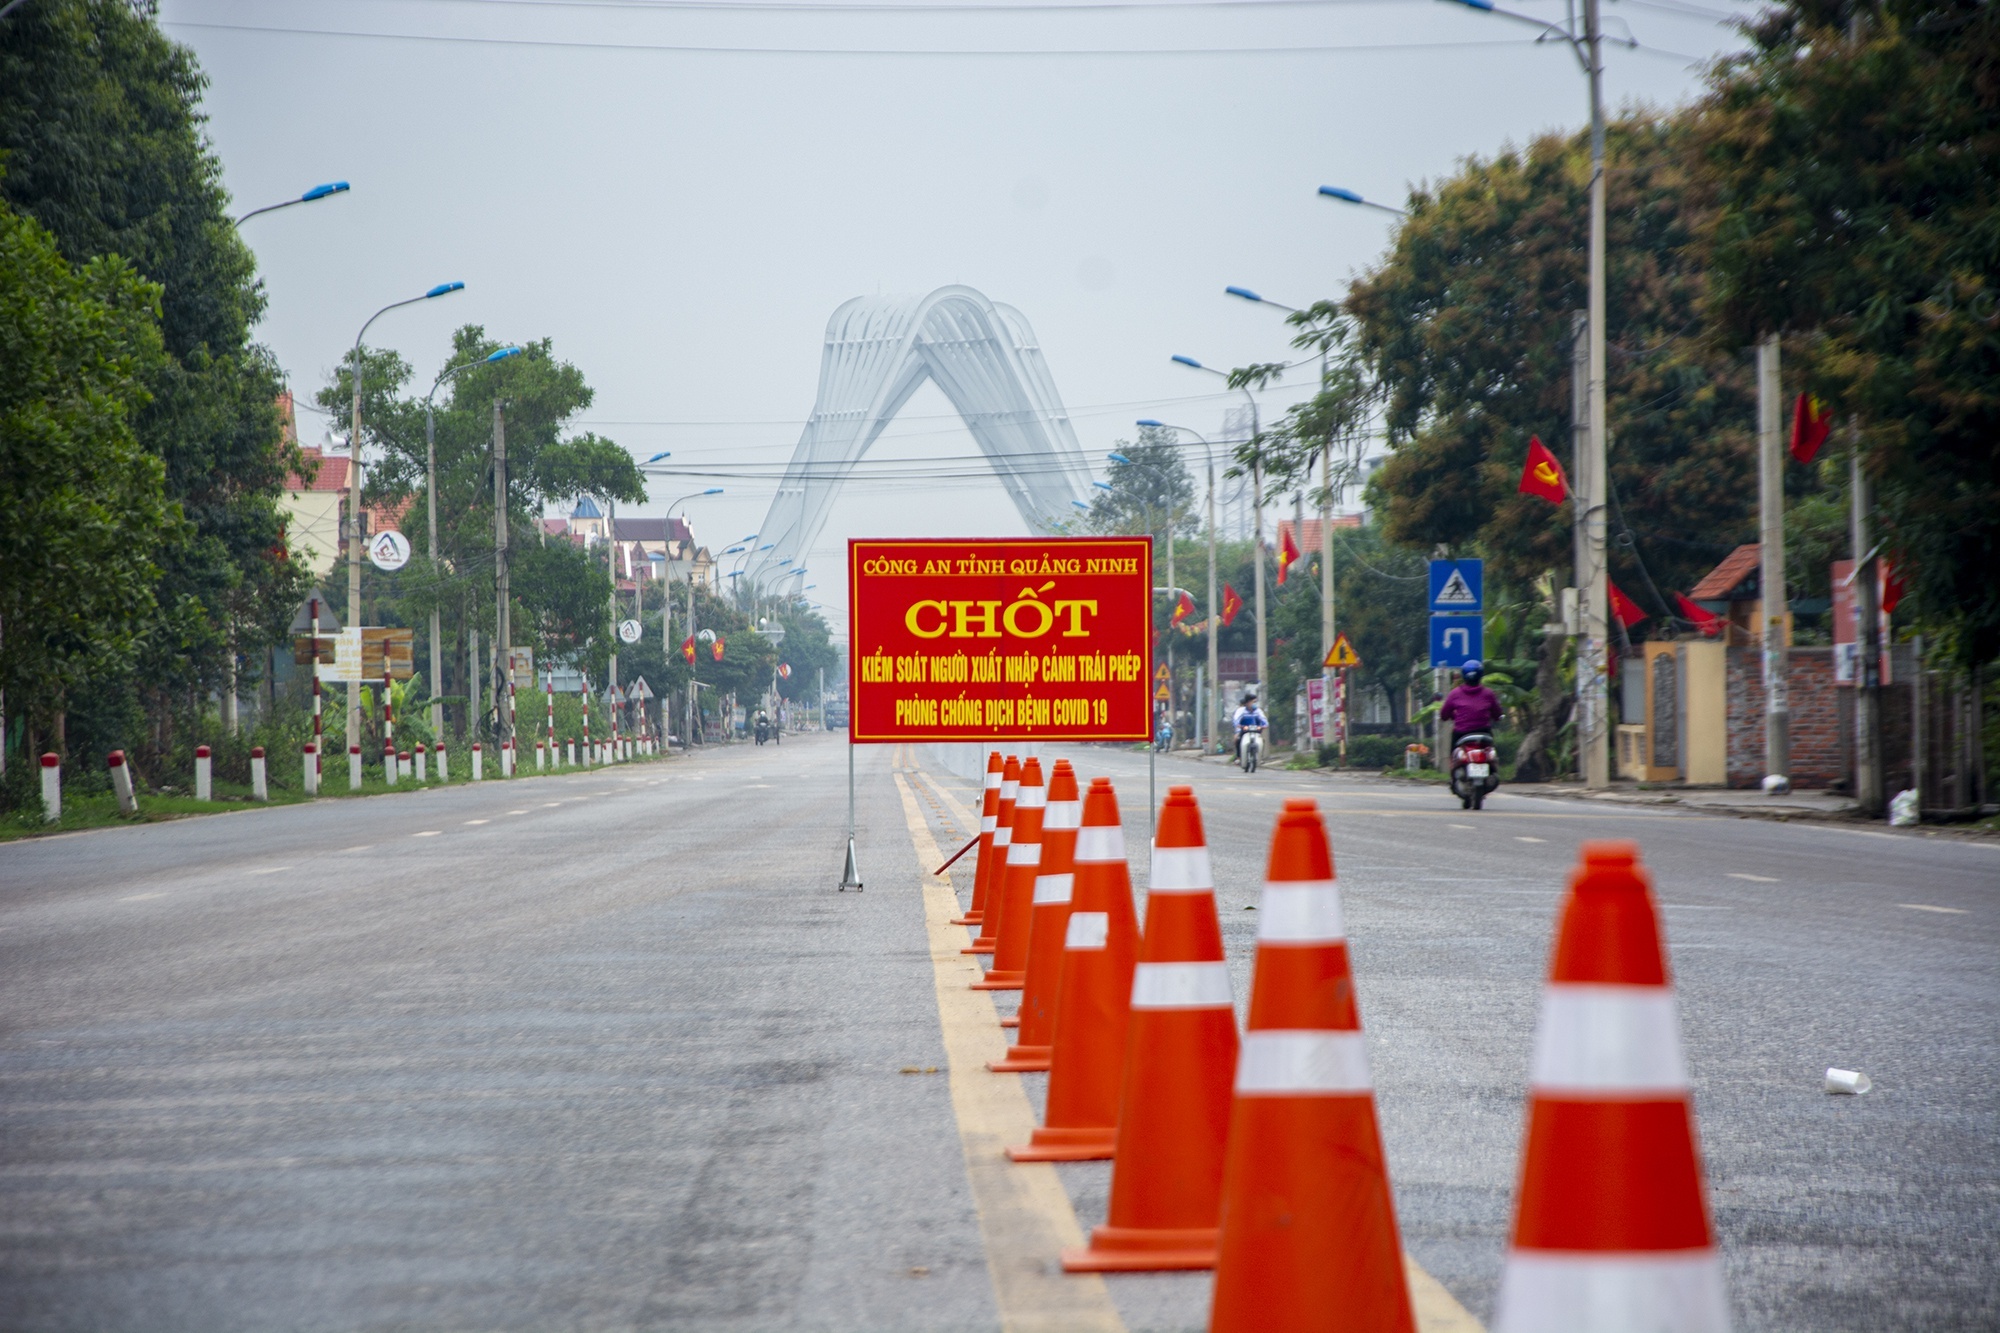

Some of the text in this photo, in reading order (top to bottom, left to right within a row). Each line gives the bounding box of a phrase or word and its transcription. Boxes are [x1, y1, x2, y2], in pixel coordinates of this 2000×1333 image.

[863, 552, 1138, 575] CÔNG AN TỈNH QUẢNG NINH
[905, 580, 1098, 639] CHỐT
[862, 644, 1141, 689] KIỂM SOÁT NGƯỜI XUẤT NHẬP CẢNH TRÁI PHÉP
[896, 690, 1108, 732] PHÒNG CHỐNG DỊCH BỆNH COVID 19
